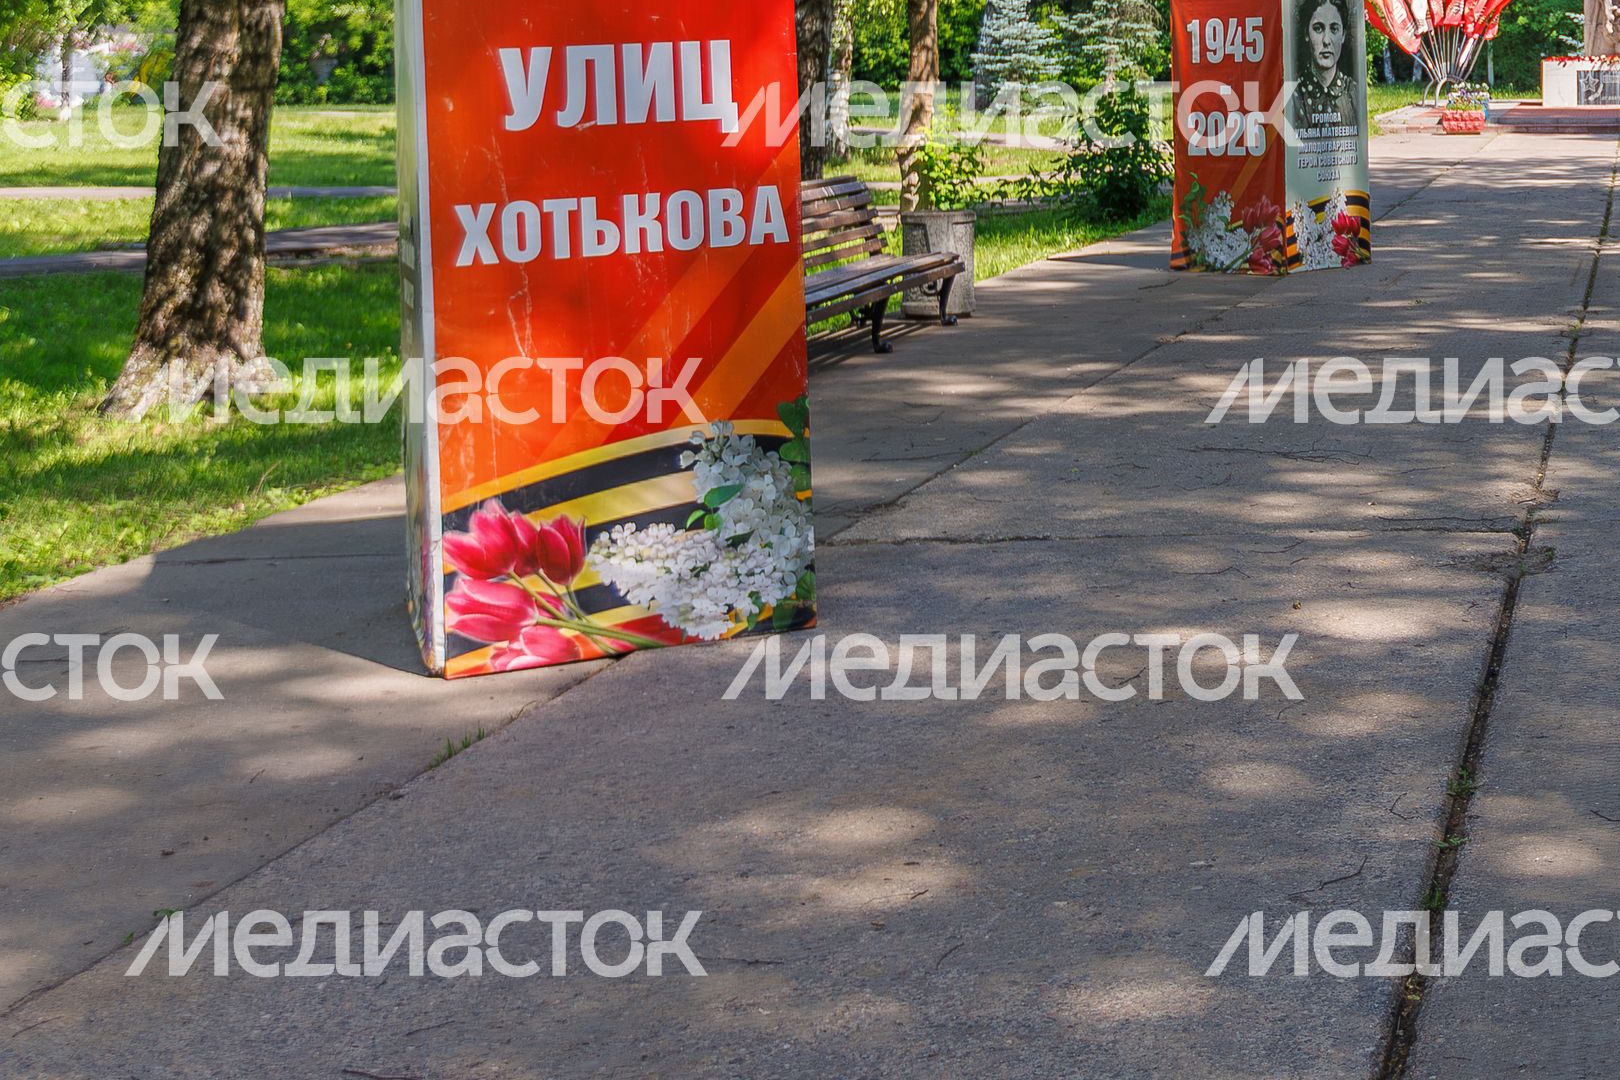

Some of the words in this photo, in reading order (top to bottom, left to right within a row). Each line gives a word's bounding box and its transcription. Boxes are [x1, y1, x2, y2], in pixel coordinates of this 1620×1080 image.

[1187, 17, 1264, 64] 1945
[499, 39, 739, 133] УЛИЦ
[1187, 111, 1266, 157] 2026
[1312, 112, 1341, 123] ГРОМОВА
[454, 184, 790, 268] ХОТЬКОВА
